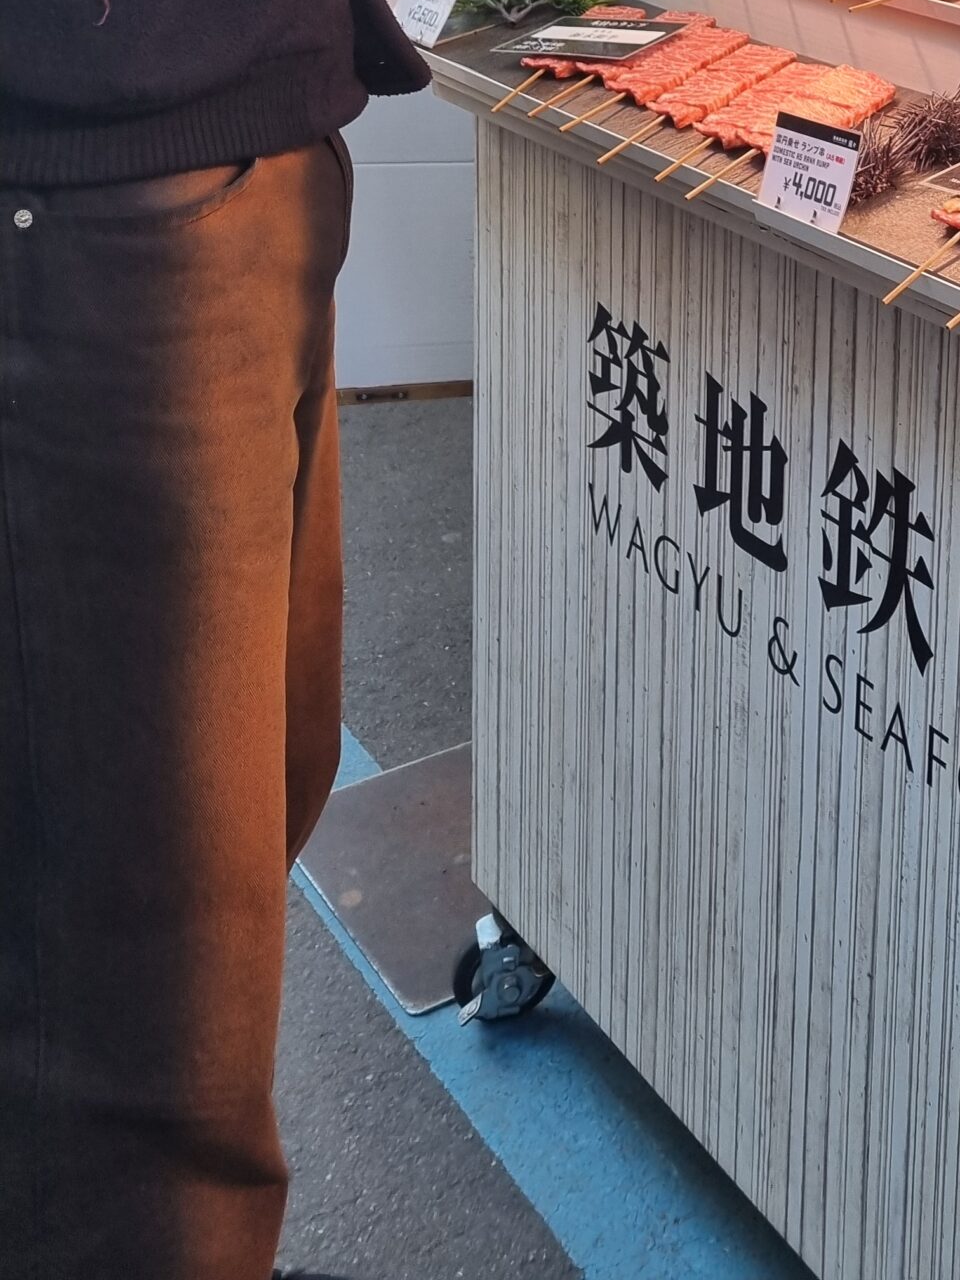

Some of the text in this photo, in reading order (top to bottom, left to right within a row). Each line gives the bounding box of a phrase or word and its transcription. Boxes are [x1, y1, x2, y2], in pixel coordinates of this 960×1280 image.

[782, 170, 838, 207] ¥4,000
[587, 482, 743, 639] WAGYU
[766, 616, 800, 688] &
